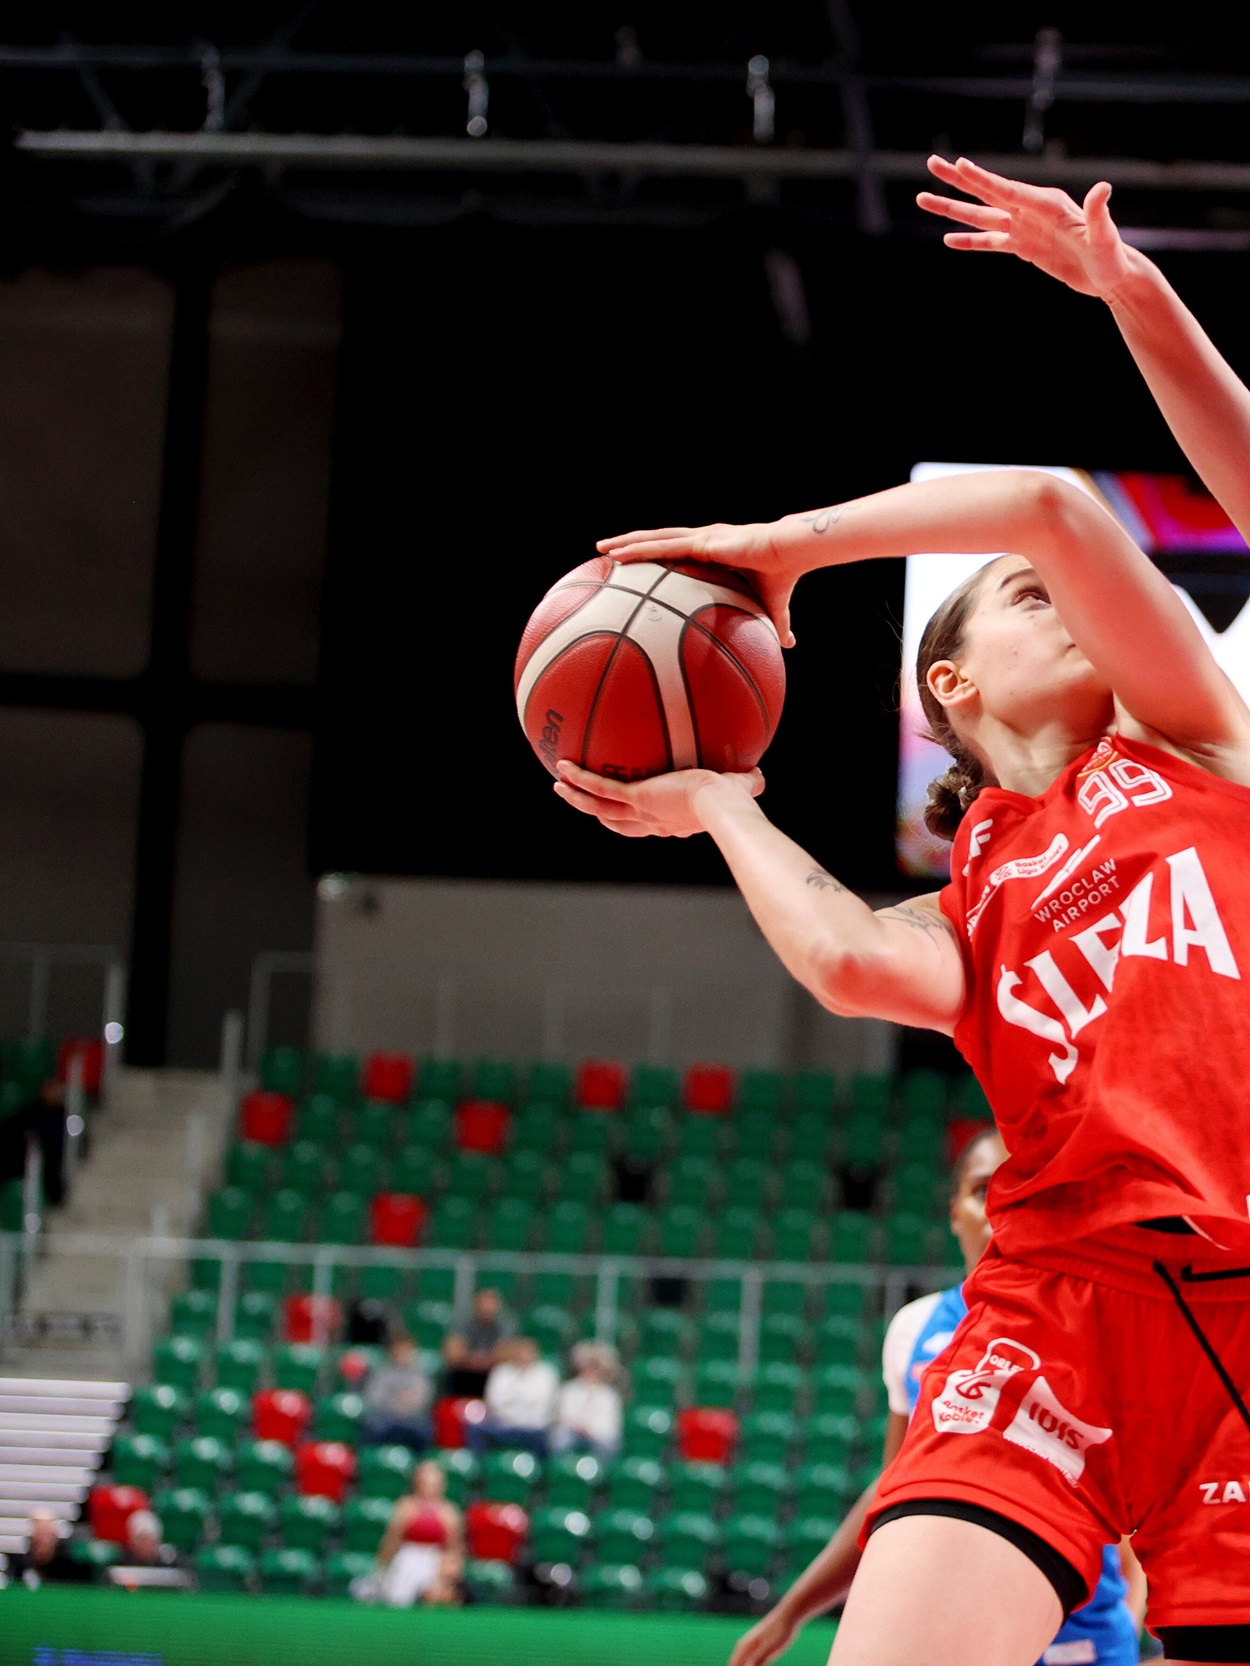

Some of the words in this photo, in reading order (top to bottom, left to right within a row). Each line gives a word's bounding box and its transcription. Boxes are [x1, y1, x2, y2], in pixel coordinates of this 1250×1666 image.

[1078, 758, 1173, 829] 99
[1034, 858, 1117, 923] WROCLAW
[1052, 875, 1120, 932] AIRPORT
